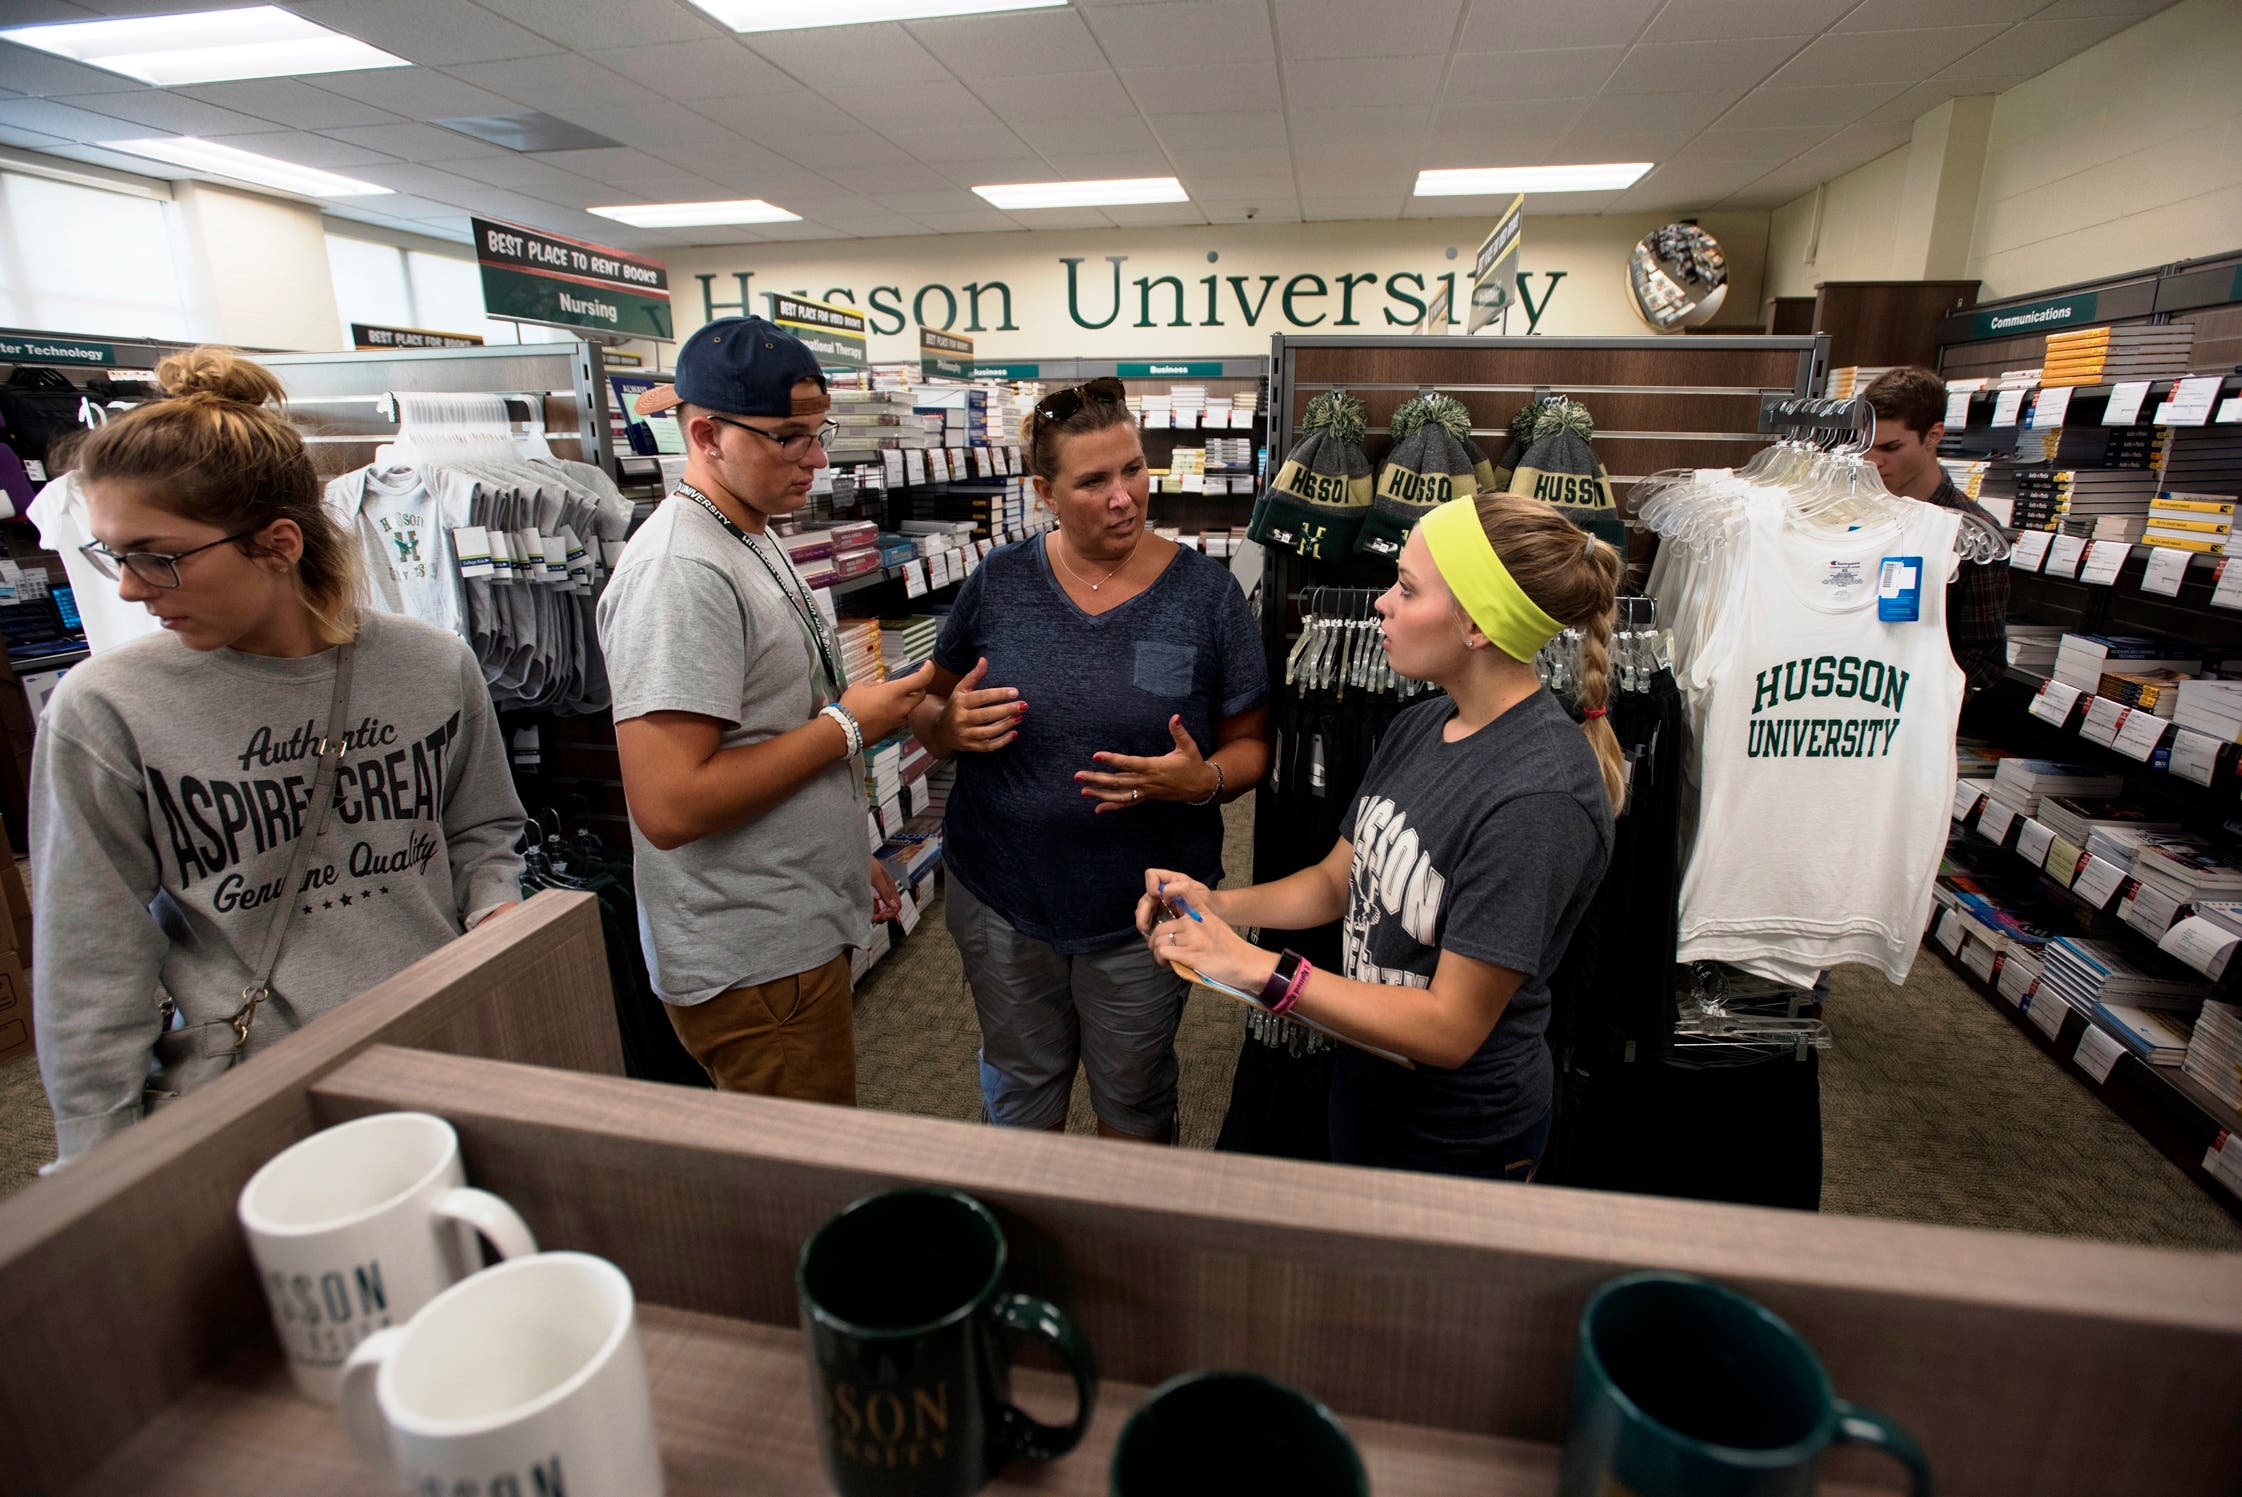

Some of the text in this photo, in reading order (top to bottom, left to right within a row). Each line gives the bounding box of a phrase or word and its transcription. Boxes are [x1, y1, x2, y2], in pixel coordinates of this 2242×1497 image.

[487, 229, 658, 285] BEST PLACE TO RENT BOOKS
[558, 291, 619, 323] Nursing
[695, 271, 1020, 337] Hson
[1058, 246, 1568, 336] Universiy
[779, 299, 862, 329] BEST PLACE FOR USED BOOKS
[1990, 306, 2073, 330] Communications
[0, 342, 104, 361] ter Technology
[367, 329, 393, 345] BEST
[394, 333, 424, 347] PLACE
[835, 342, 863, 360] Therapy
[1148, 365, 1189, 375] Business
[679, 482, 731, 526] UNIVERSITY
[1387, 468, 1452, 504] HUSSO
[1751, 655, 1910, 715] HUSSON
[1747, 718, 1901, 758] UNIVERSITY
[145, 765, 308, 890] ASPIRE
[213, 829, 438, 913] Genune Quality
